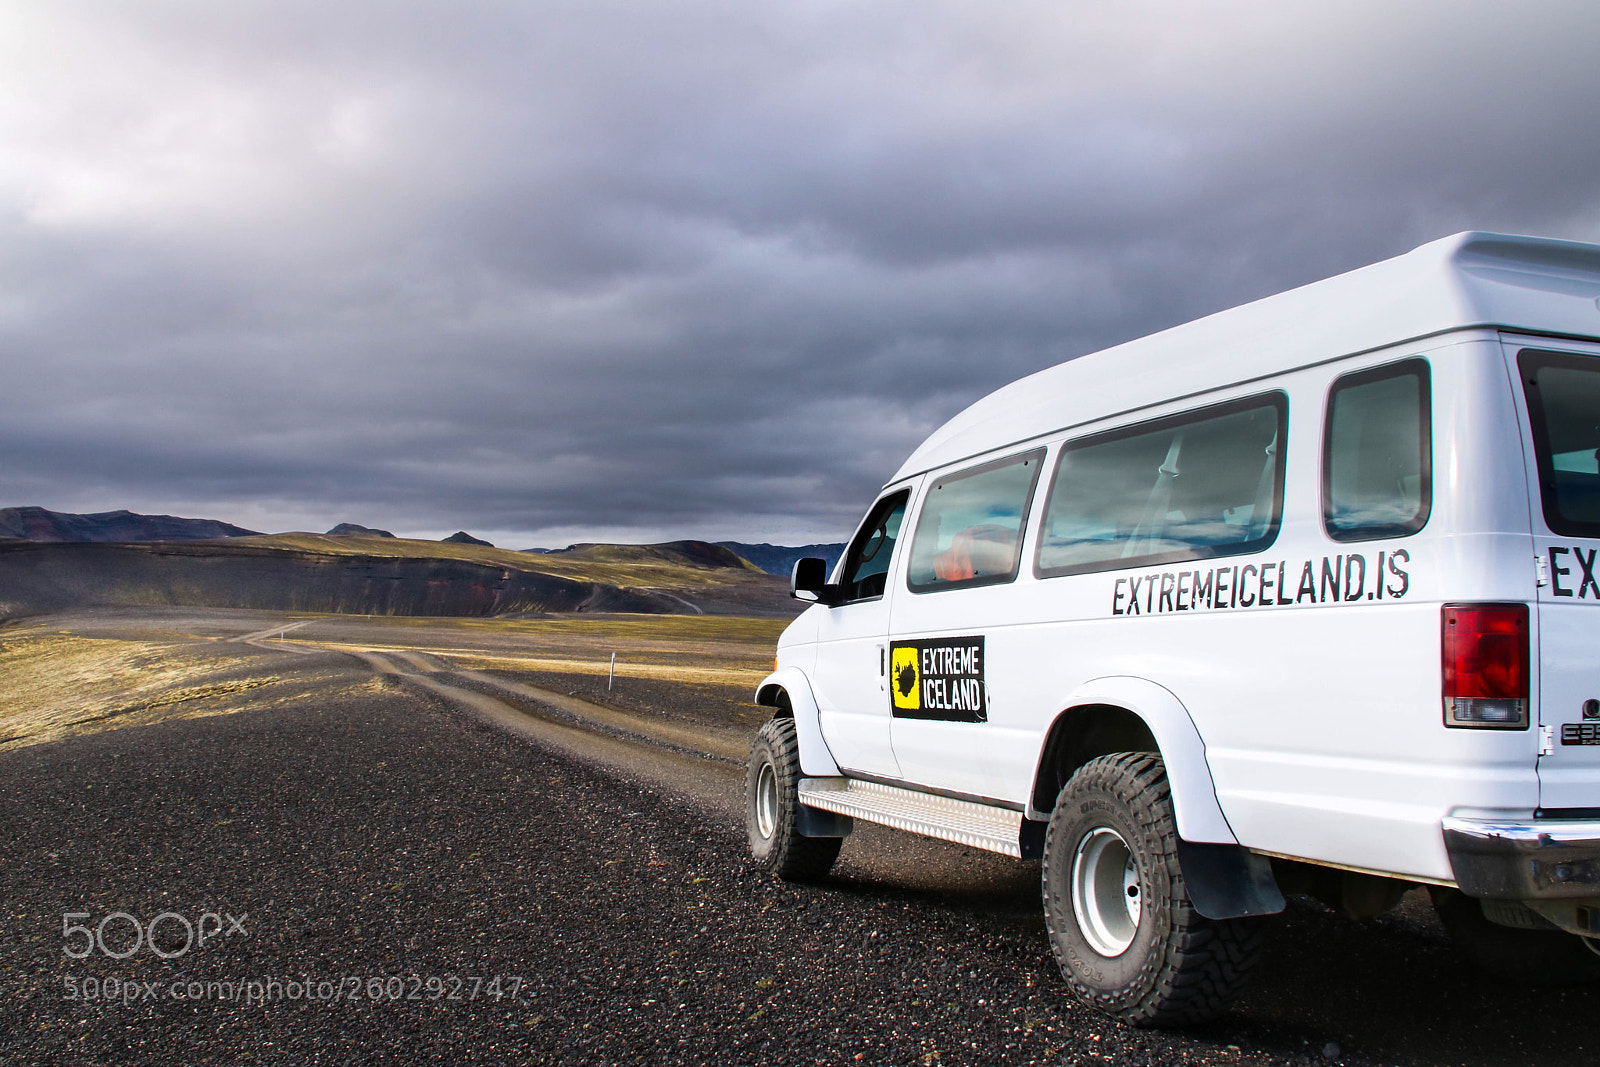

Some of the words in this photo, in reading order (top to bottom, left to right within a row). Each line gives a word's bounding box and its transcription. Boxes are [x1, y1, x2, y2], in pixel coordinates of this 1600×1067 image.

[1112, 548, 1410, 616] EXTREMEICELAND.IS
[1548, 546, 1600, 600] EX
[922, 646, 980, 675] EXTREME
[922, 678, 981, 711] ICELAND
